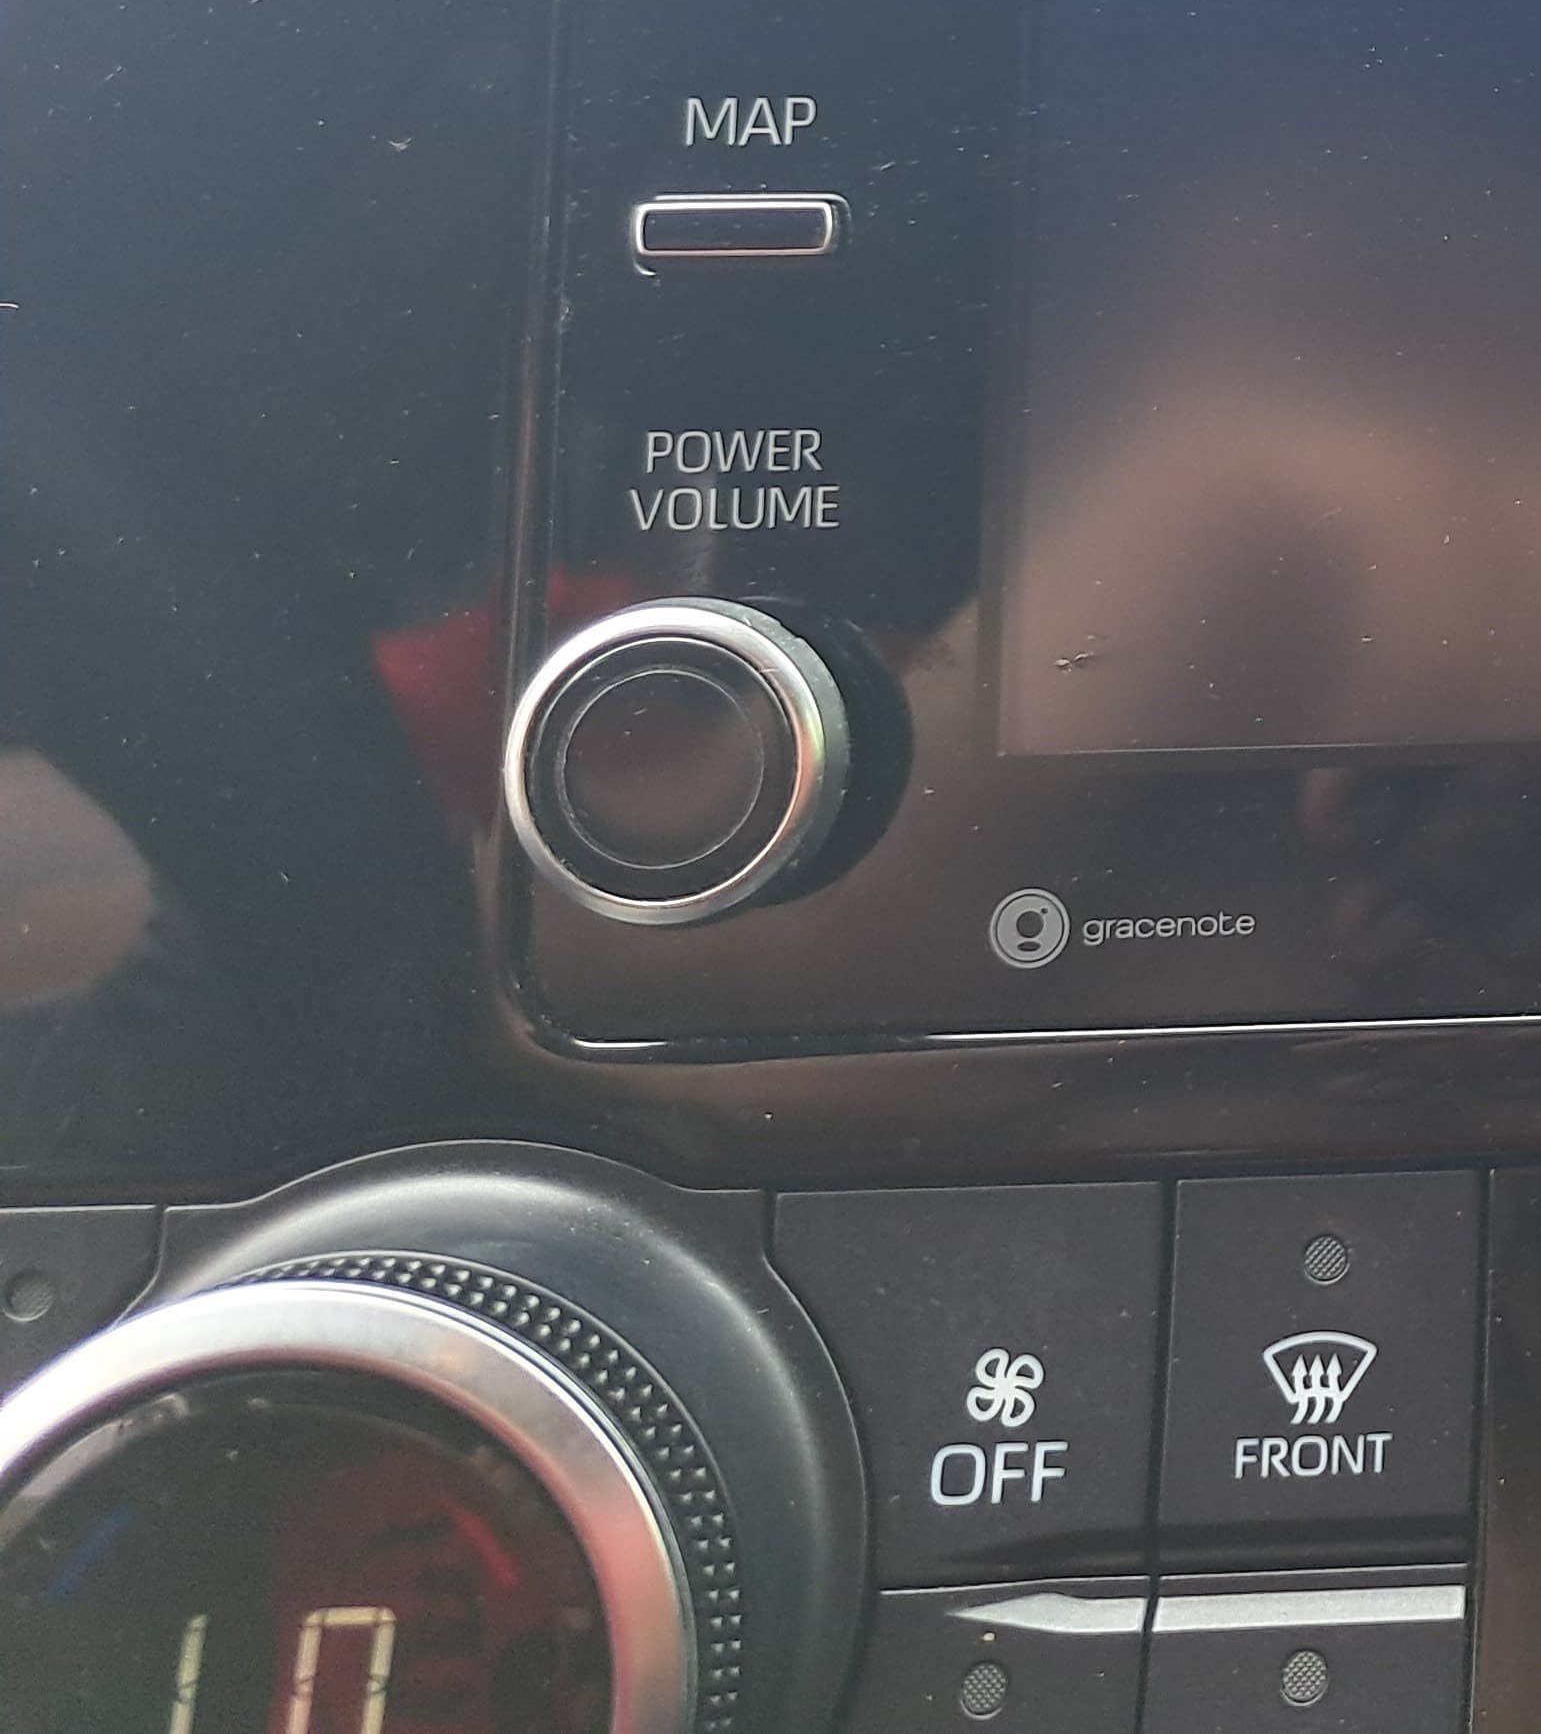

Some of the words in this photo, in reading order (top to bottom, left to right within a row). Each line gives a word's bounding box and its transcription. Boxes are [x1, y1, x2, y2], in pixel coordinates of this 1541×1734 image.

[686, 98, 815, 145] MAP
[647, 430, 821, 473] POWER
[631, 487, 838, 530] VOLUME
[1083, 913, 1254, 945] gracenote
[931, 1443, 1067, 1505] OFF
[1236, 1434, 1391, 1478] FRONT
